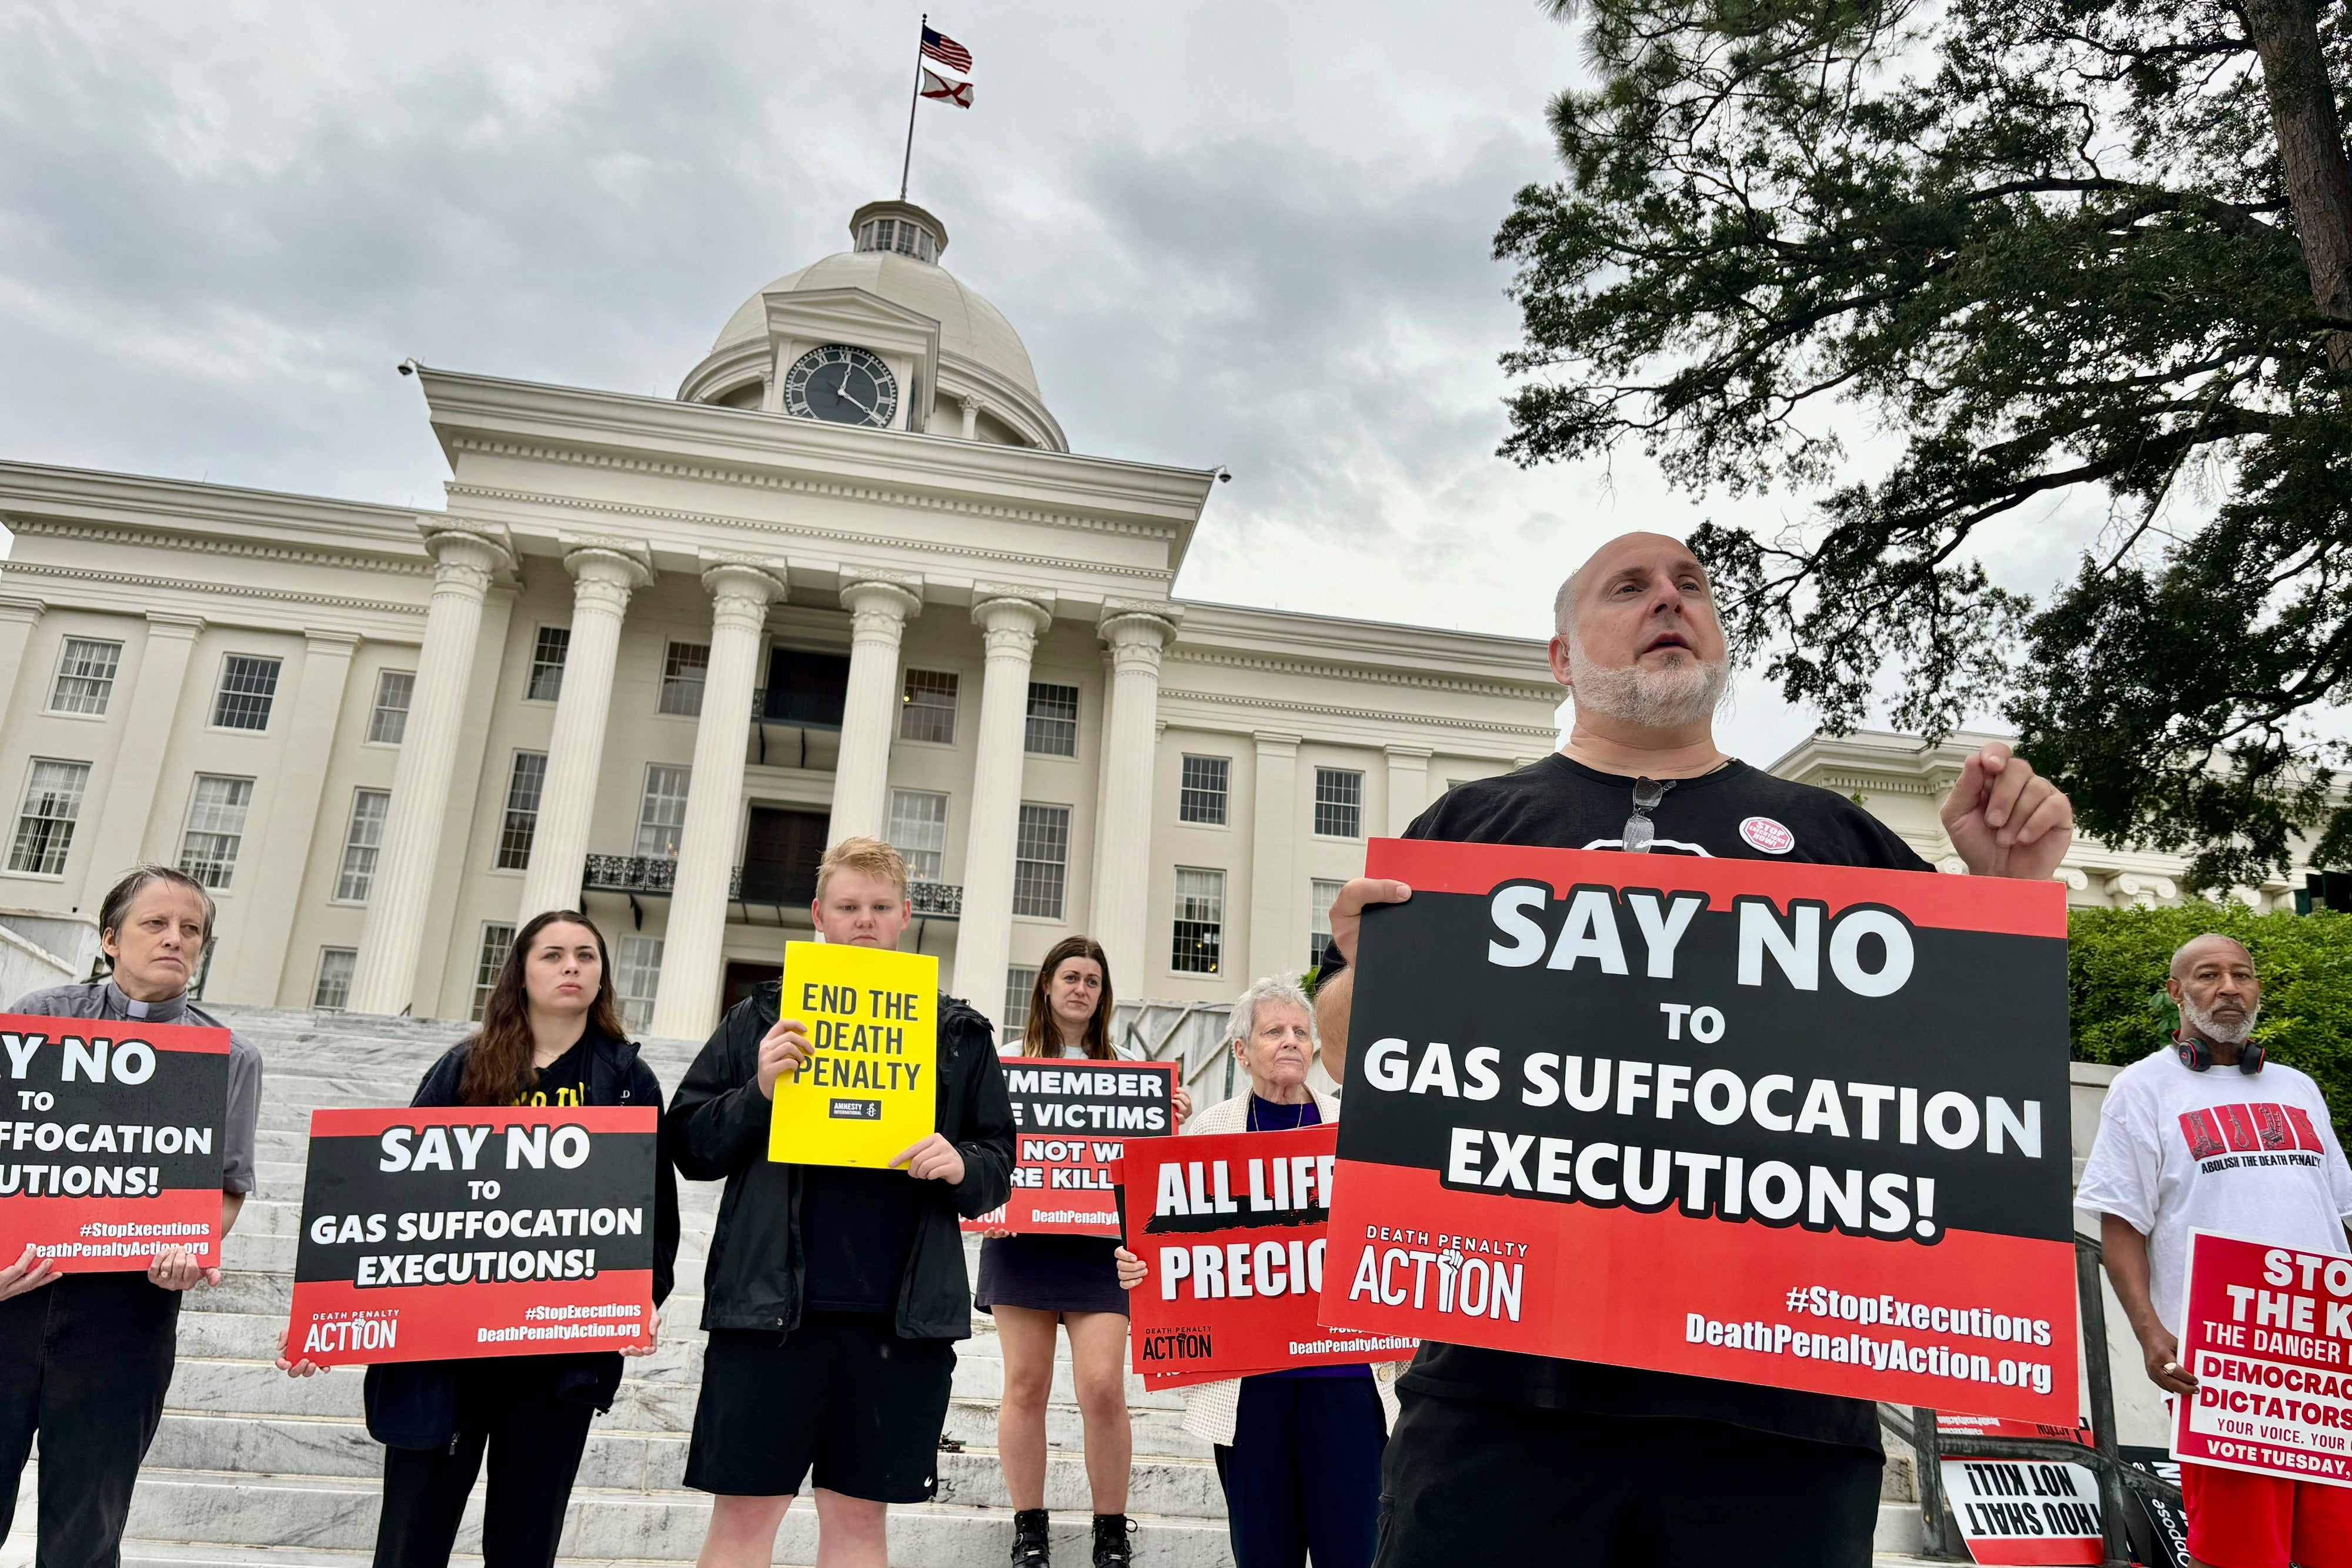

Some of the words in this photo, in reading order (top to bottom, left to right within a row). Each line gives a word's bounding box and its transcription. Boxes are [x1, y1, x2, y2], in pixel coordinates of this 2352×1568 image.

[1756, 821, 1785, 837] STOP
[1488, 885, 1702, 979] SAY
[1737, 902, 1915, 997] NO
[803, 982, 857, 1015] END
[869, 989, 918, 1021] THE
[815, 1020, 903, 1055] DEATH
[1660, 1002, 1726, 1044] TO
[61, 1039, 156, 1085] NO
[793, 1056, 921, 1091] PENALTY
[18, 1091, 54, 1111] TO
[834, 1102, 863, 1111] AMNESTY
[1364, 1038, 1501, 1101] GAS
[1521, 1052, 2042, 1158] SUFFOCATION
[1033, 1104, 1165, 1130] VICTIMS
[379, 1127, 494, 1172] SAY
[505, 1126, 591, 1170] NO
[1023, 1141, 1085, 1162] NOT
[1091, 1142, 1123, 1162] W
[2201, 1156, 2240, 1175] ABOLISH
[2241, 1156, 2259, 1167] THE
[2260, 1155, 2288, 1166] DEATH
[2288, 1154, 2321, 1168] PENALTY
[467, 1180, 500, 1200] TO
[1051, 1168, 1114, 1189] KILL
[1155, 1161, 1238, 1216] ALL
[1448, 1127, 1936, 1236] EXECUTIONS!
[80, 1222, 209, 1238] #StopExecutions
[310, 1213, 386, 1244] GAS
[397, 1208, 643, 1241] SUFFOCATION
[1367, 1225, 1429, 1246] DEATH
[1438, 1234, 1529, 1258] PENALTY
[357, 1249, 596, 1286] EXECUTIONS!
[1349, 1245, 1524, 1322] ACTION
[2263, 1249, 2352, 1298] STO
[313, 1311, 348, 1320] DEATH
[352, 1309, 400, 1319] PENALTY
[525, 1305, 641, 1321] #StopExecutions
[1785, 1286, 2052, 1346] #StopExecutions
[2227, 1284, 2315, 1333] THE
[303, 1318, 397, 1353] ACTION
[477, 1324, 641, 1343] DeathPenaltyAction.org
[1142, 1333, 1211, 1360] ACTION
[2203, 1320, 2246, 1349] THE
[2254, 1329, 2340, 1365] DANGER
[1685, 1312, 2052, 1395] DeathPenaltyAction.org
[2217, 1417, 2253, 1436] YOUR
[2260, 1425, 2305, 1445] VOICE.
[2311, 1433, 2345, 1450] YOUR
[2206, 1439, 2257, 1462] VOTE
[2261, 1449, 2351, 1480] TUESDAY,
[1963, 1463, 2029, 1496] KILL!
[2028, 1465, 2078, 1497] NOT
[1965, 1502, 2044, 1536] SHALT
[2042, 1503, 2102, 1535] THOU
